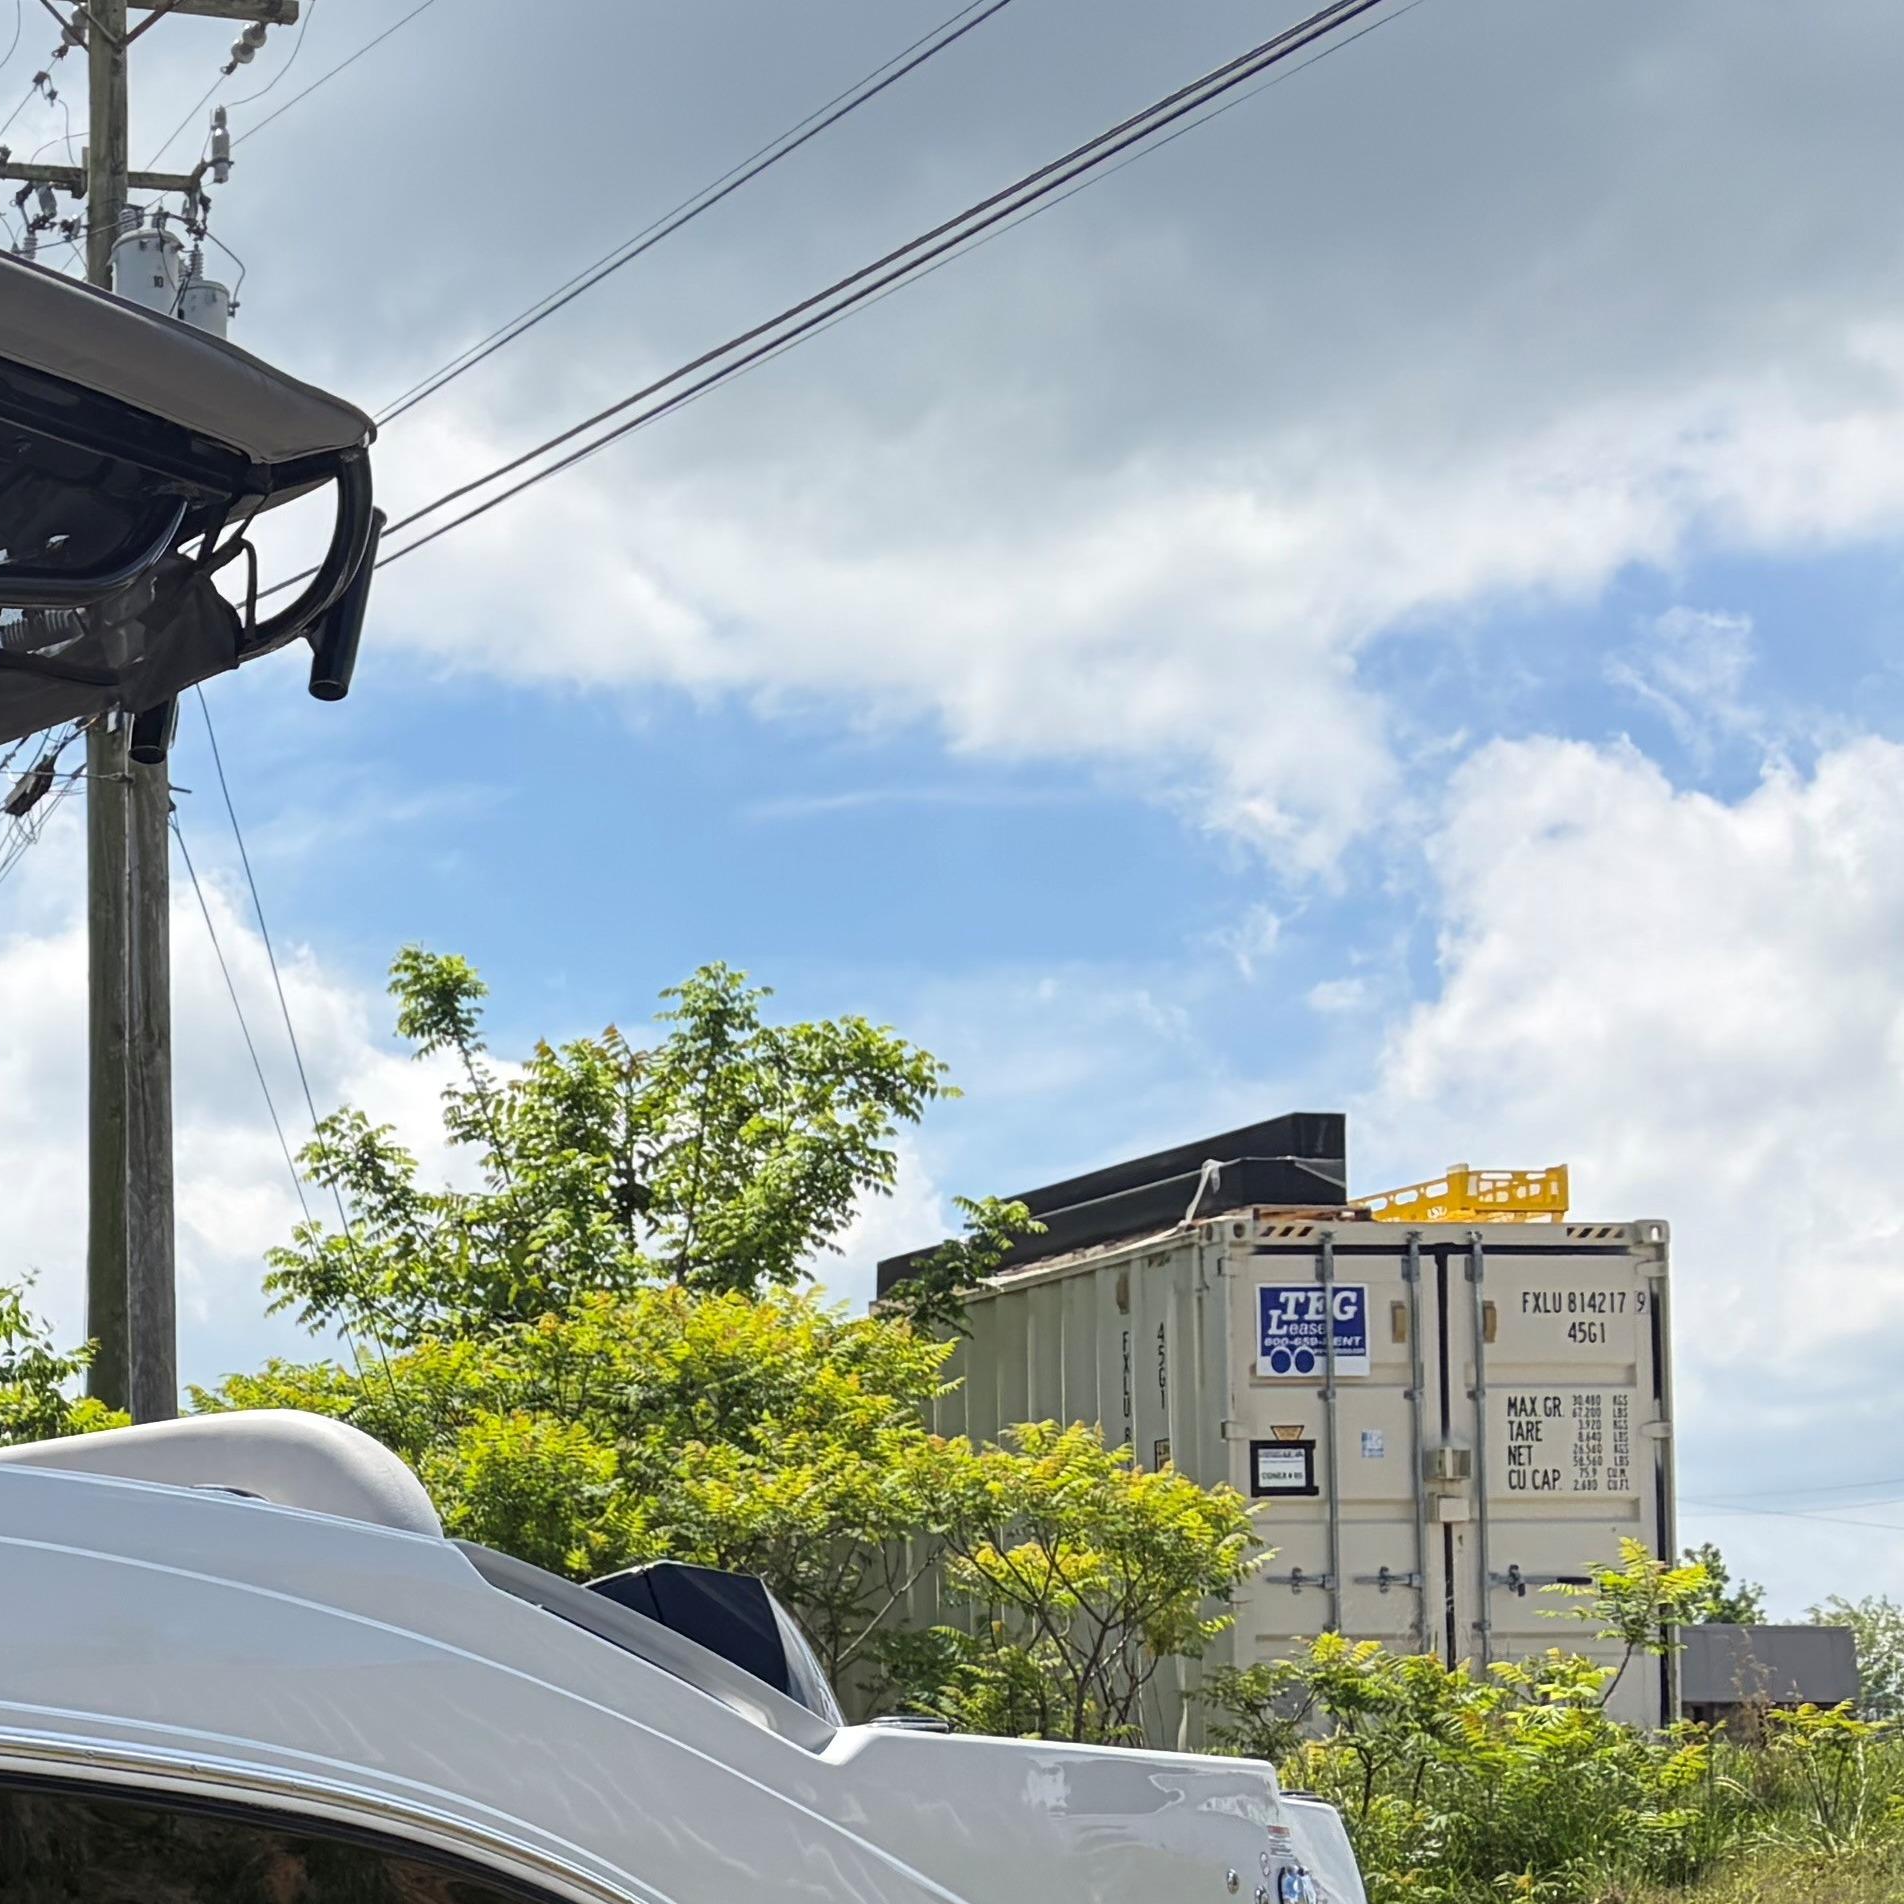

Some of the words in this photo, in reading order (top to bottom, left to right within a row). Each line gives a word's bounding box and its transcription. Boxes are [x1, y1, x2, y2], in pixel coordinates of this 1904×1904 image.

[1279, 1291, 1358, 1320] TEG
[1522, 1291, 1562, 1313] FXLU
[1567, 1291, 1626, 1313] 814217
[1636, 1291, 1646, 1312] 9
[1263, 1336, 1361, 1346] 800-659-ENT
[1567, 1321, 1606, 1343] 45G1
[1122, 1331, 1131, 1417] FXLU
[1507, 1420, 1543, 1442] TARE
[1508, 1445, 1533, 1466] NET
